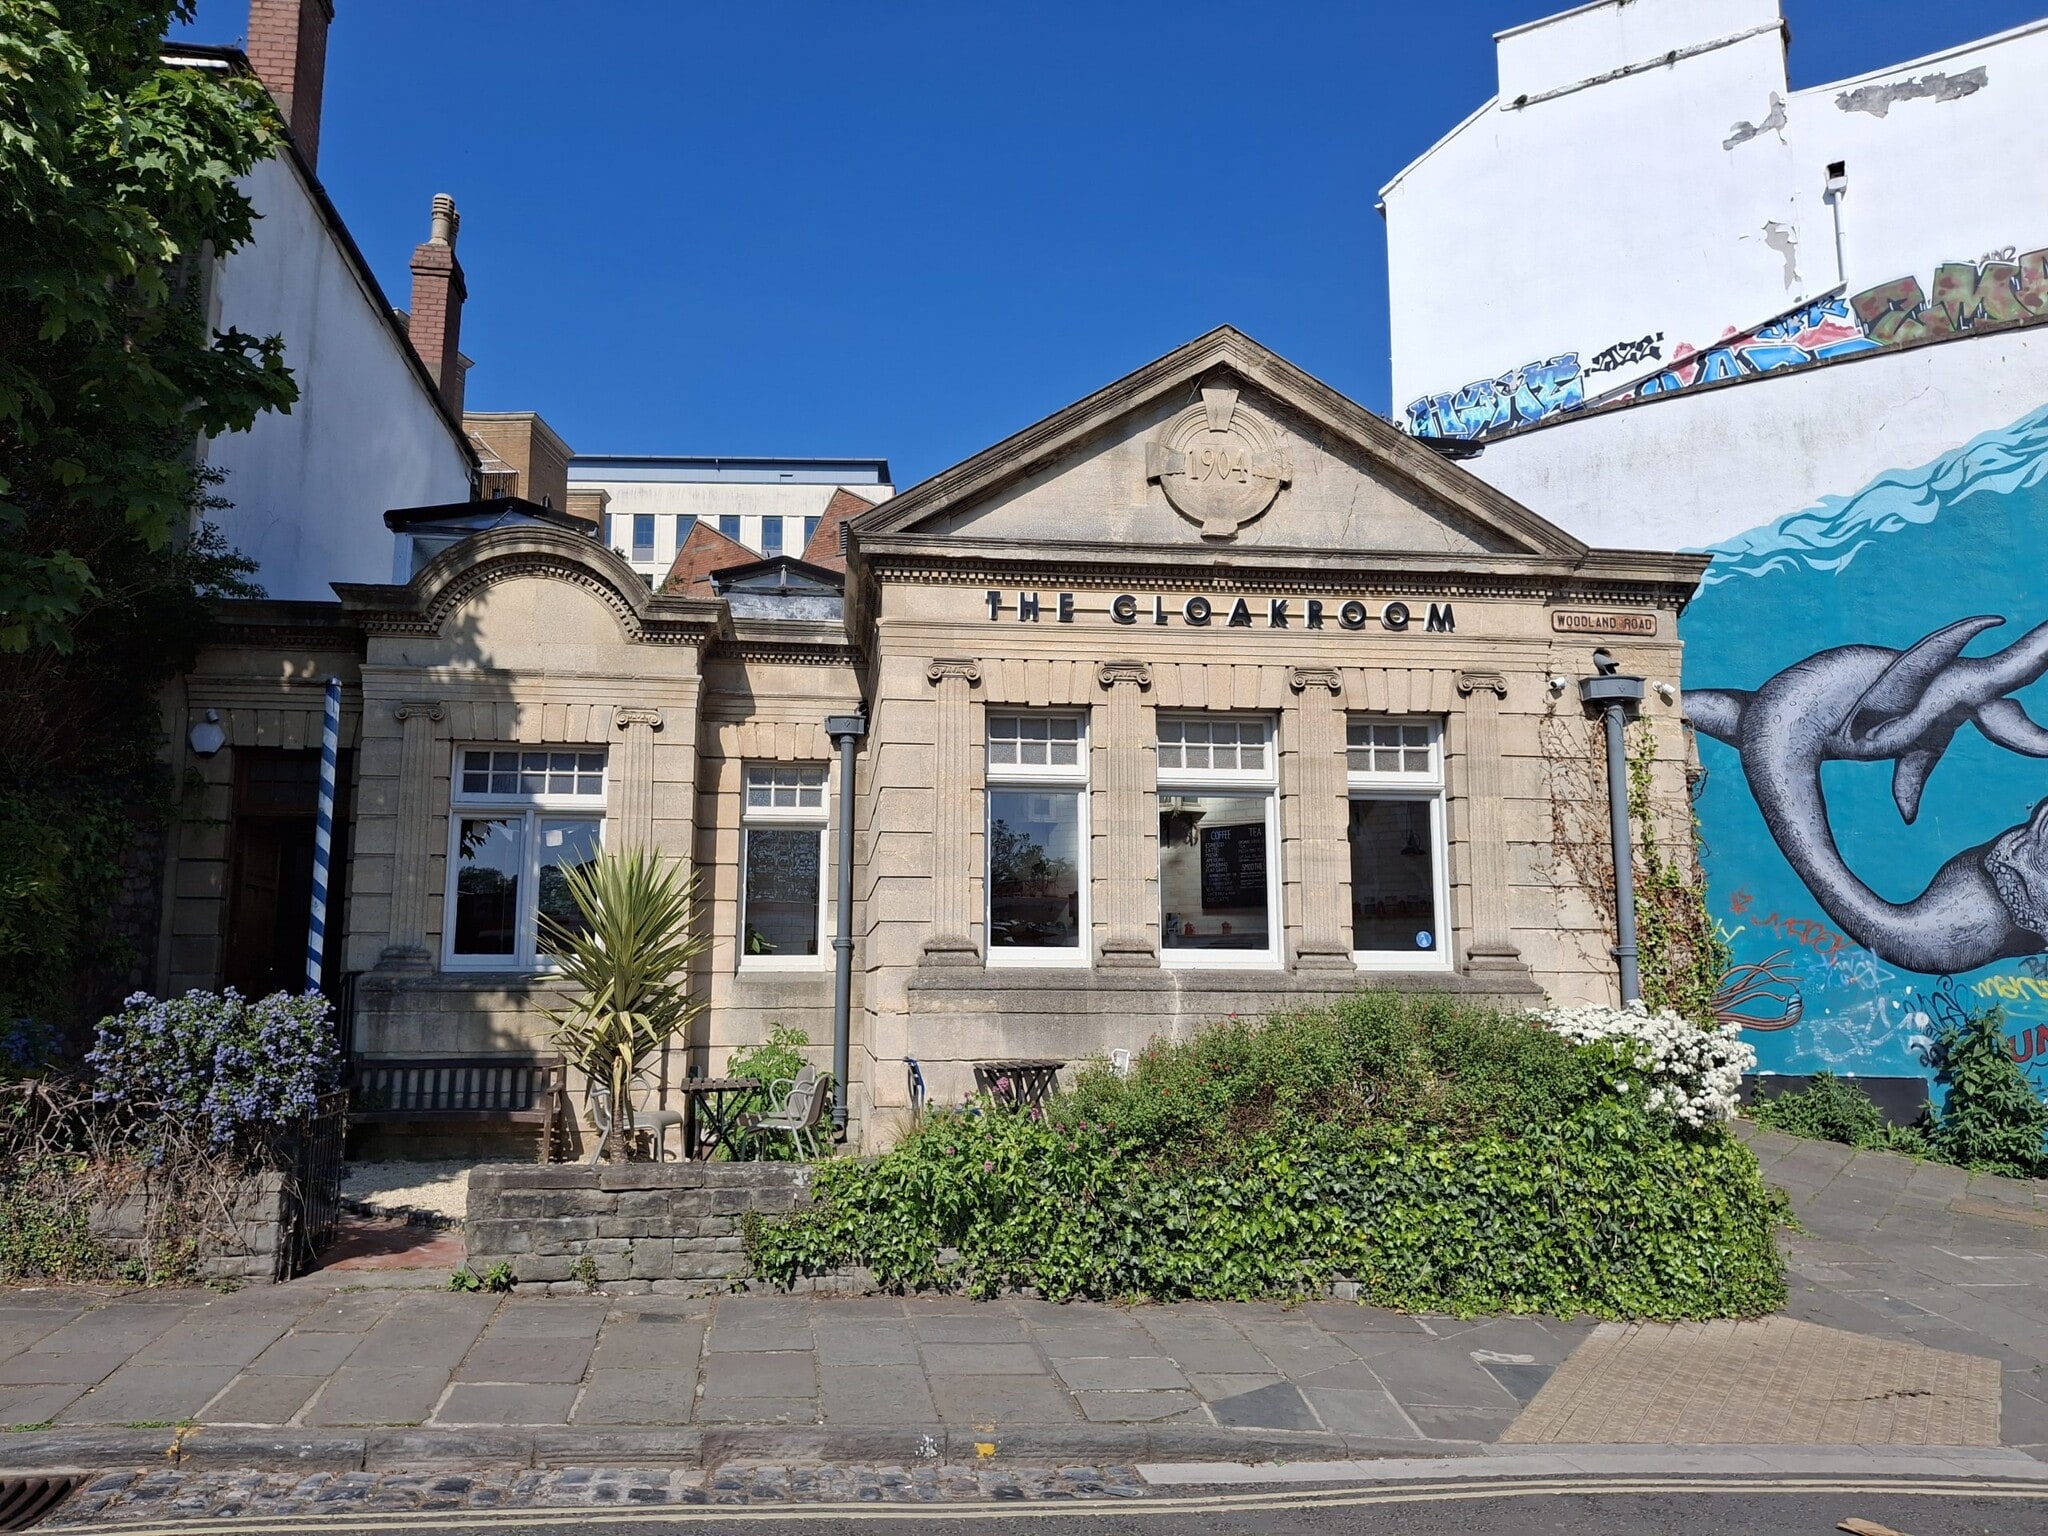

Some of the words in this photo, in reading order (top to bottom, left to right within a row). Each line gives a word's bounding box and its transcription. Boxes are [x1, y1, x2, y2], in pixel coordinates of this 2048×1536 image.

[1188, 447, 1248, 484] 1904
[985, 590, 1074, 622] THE
[1110, 594, 1456, 633] CLOAKROOM
[1557, 615, 1617, 629] WOODLAND
[1624, 618, 1653, 631] ROAD
[1210, 830, 1231, 840] COFFEE
[1248, 827, 1262, 837] TEA
